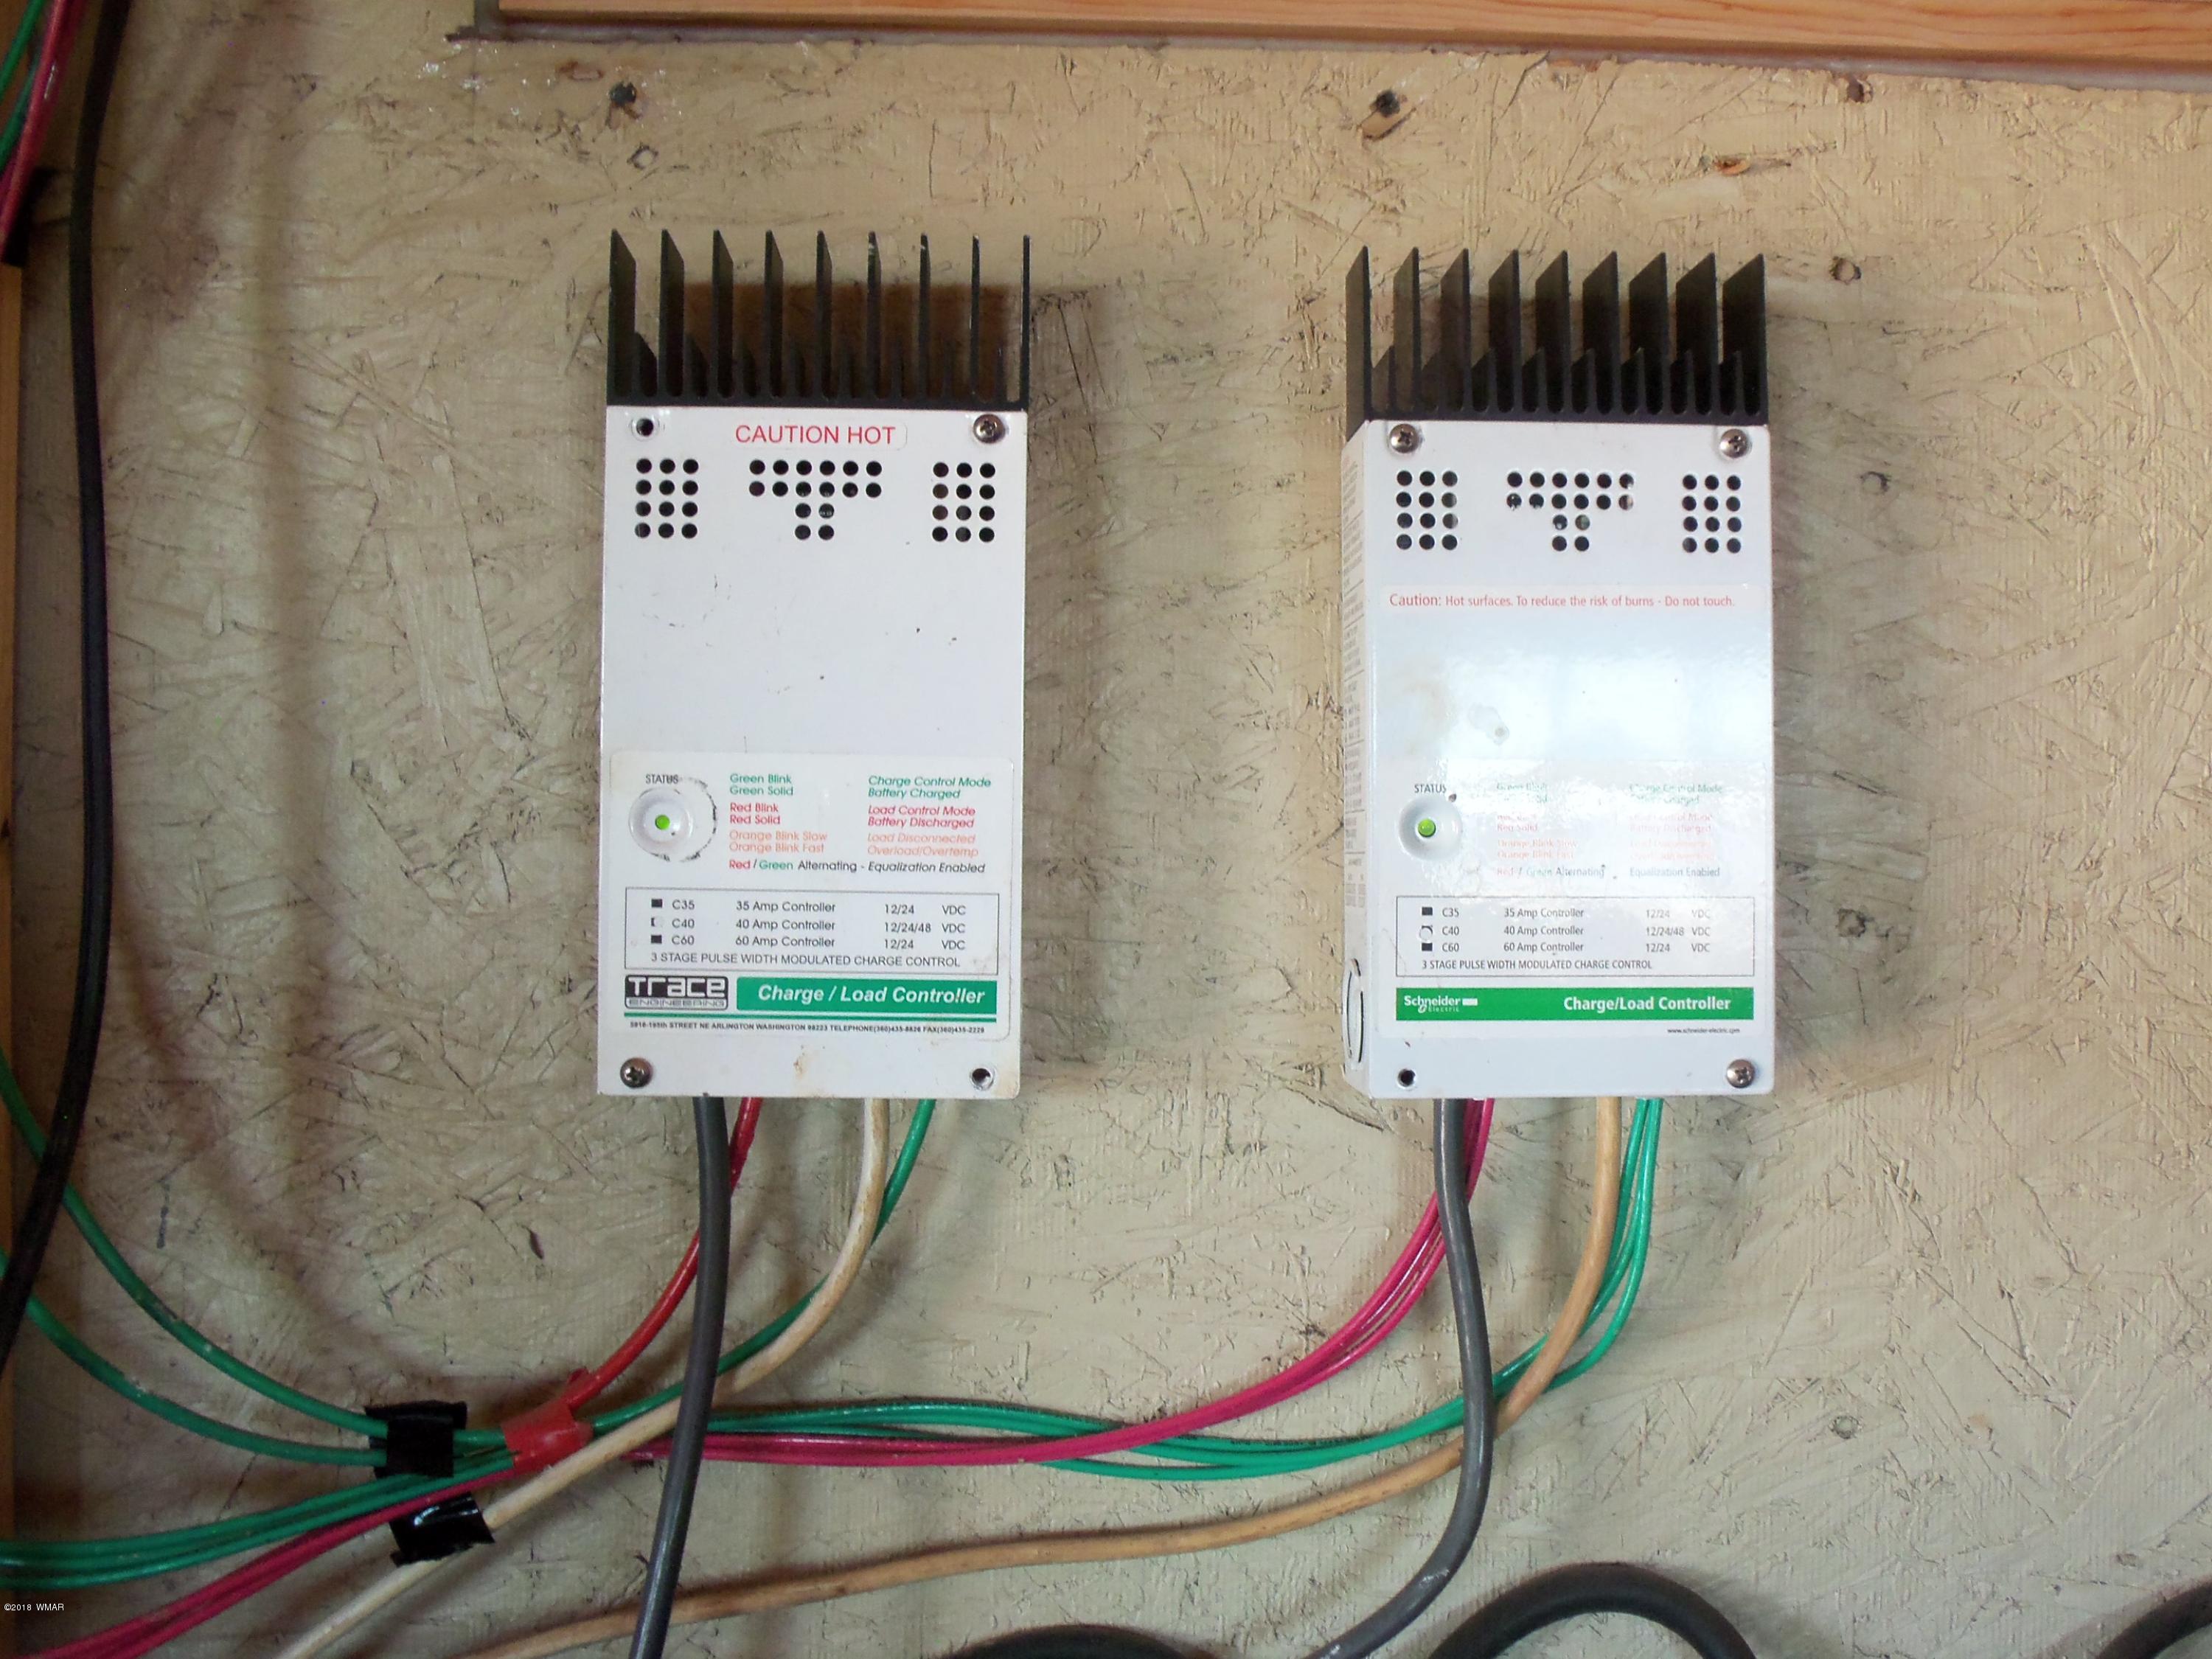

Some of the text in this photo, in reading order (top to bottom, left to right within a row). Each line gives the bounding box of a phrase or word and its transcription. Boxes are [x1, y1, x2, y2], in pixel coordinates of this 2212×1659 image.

[735, 425, 897, 445] CAUTION HOT
[1389, 594, 1441, 607] Caution:
[1445, 595, 1464, 607] Hot
[1468, 594, 1513, 607] surfaces.
[1516, 595, 1528, 607] To
[1531, 595, 1566, 607] reduce
[1570, 595, 1586, 607] the
[1590, 595, 1608, 607] risk
[1611, 595, 1622, 607] of
[1664, 596, 1680, 607] Do
[1683, 596, 1700, 607] not
[1703, 596, 1735, 607] touch.
[645, 774, 679, 785] STATUS
[729, 773, 792, 784] Green Blink
[868, 775, 992, 787] Charge Control Mode
[729, 785, 794, 796] Green Solid
[868, 787, 961, 800] Battery Charged
[1413, 783, 1447, 794] STATUS
[1697, 785, 1722, 795] Mode
[729, 801, 779, 813] Red Blink
[868, 805, 976, 816] Load Control Mode
[729, 814, 781, 825] Red Solid
[868, 816, 975, 830] Battery Discharged
[728, 830, 828, 841] Orange Blink Slow
[867, 833, 976, 844] Load Disconnected
[728, 842, 824, 853] Orange Blink Fast
[867, 846, 979, 860] Overload/Overtemp
[728, 860, 751, 870] Red
[759, 860, 794, 871] Green
[797, 860, 858, 873] Alternating
[867, 860, 936, 874] Equalization
[939, 862, 986, 873] Enabled
[1630, 867, 1683, 880] Equalization
[1686, 867, 1721, 877] Enabled
[672, 899, 967, 916] C35 35 Amp Controller 12/24 VDC
[1442, 907, 1711, 919] C35 35 Amp Controller 12/24 VDC
[671, 917, 966, 934] C40 40 Amp Controller 12/24/48 VDC
[1441, 925, 1711, 937] C40 40 Amp Controller 12/24/48 VDC
[671, 934, 966, 950] C60 60 Amp Controller 12/24 VDC
[1441, 942, 1711, 954] C60 60 Amp Controller 12/24 VDC
[650, 952, 961, 967] 3 STAGE PULSE WIDTH MODULATED CHARGE CONTROL
[1422, 959, 1652, 970] 3 STAGE PULSE WIDTH MODULATED CHARGE CONTROL
[757, 984, 986, 1005] Charge / Load Controller
[1403, 995, 1461, 1009] Schneider
[1563, 996, 1731, 1013] Charge/Load Controller
[669, 1022, 698, 1030] STREET
[711, 1023, 754, 1031] ARLINGTON
[756, 1023, 806, 1032] WASHINGTON
